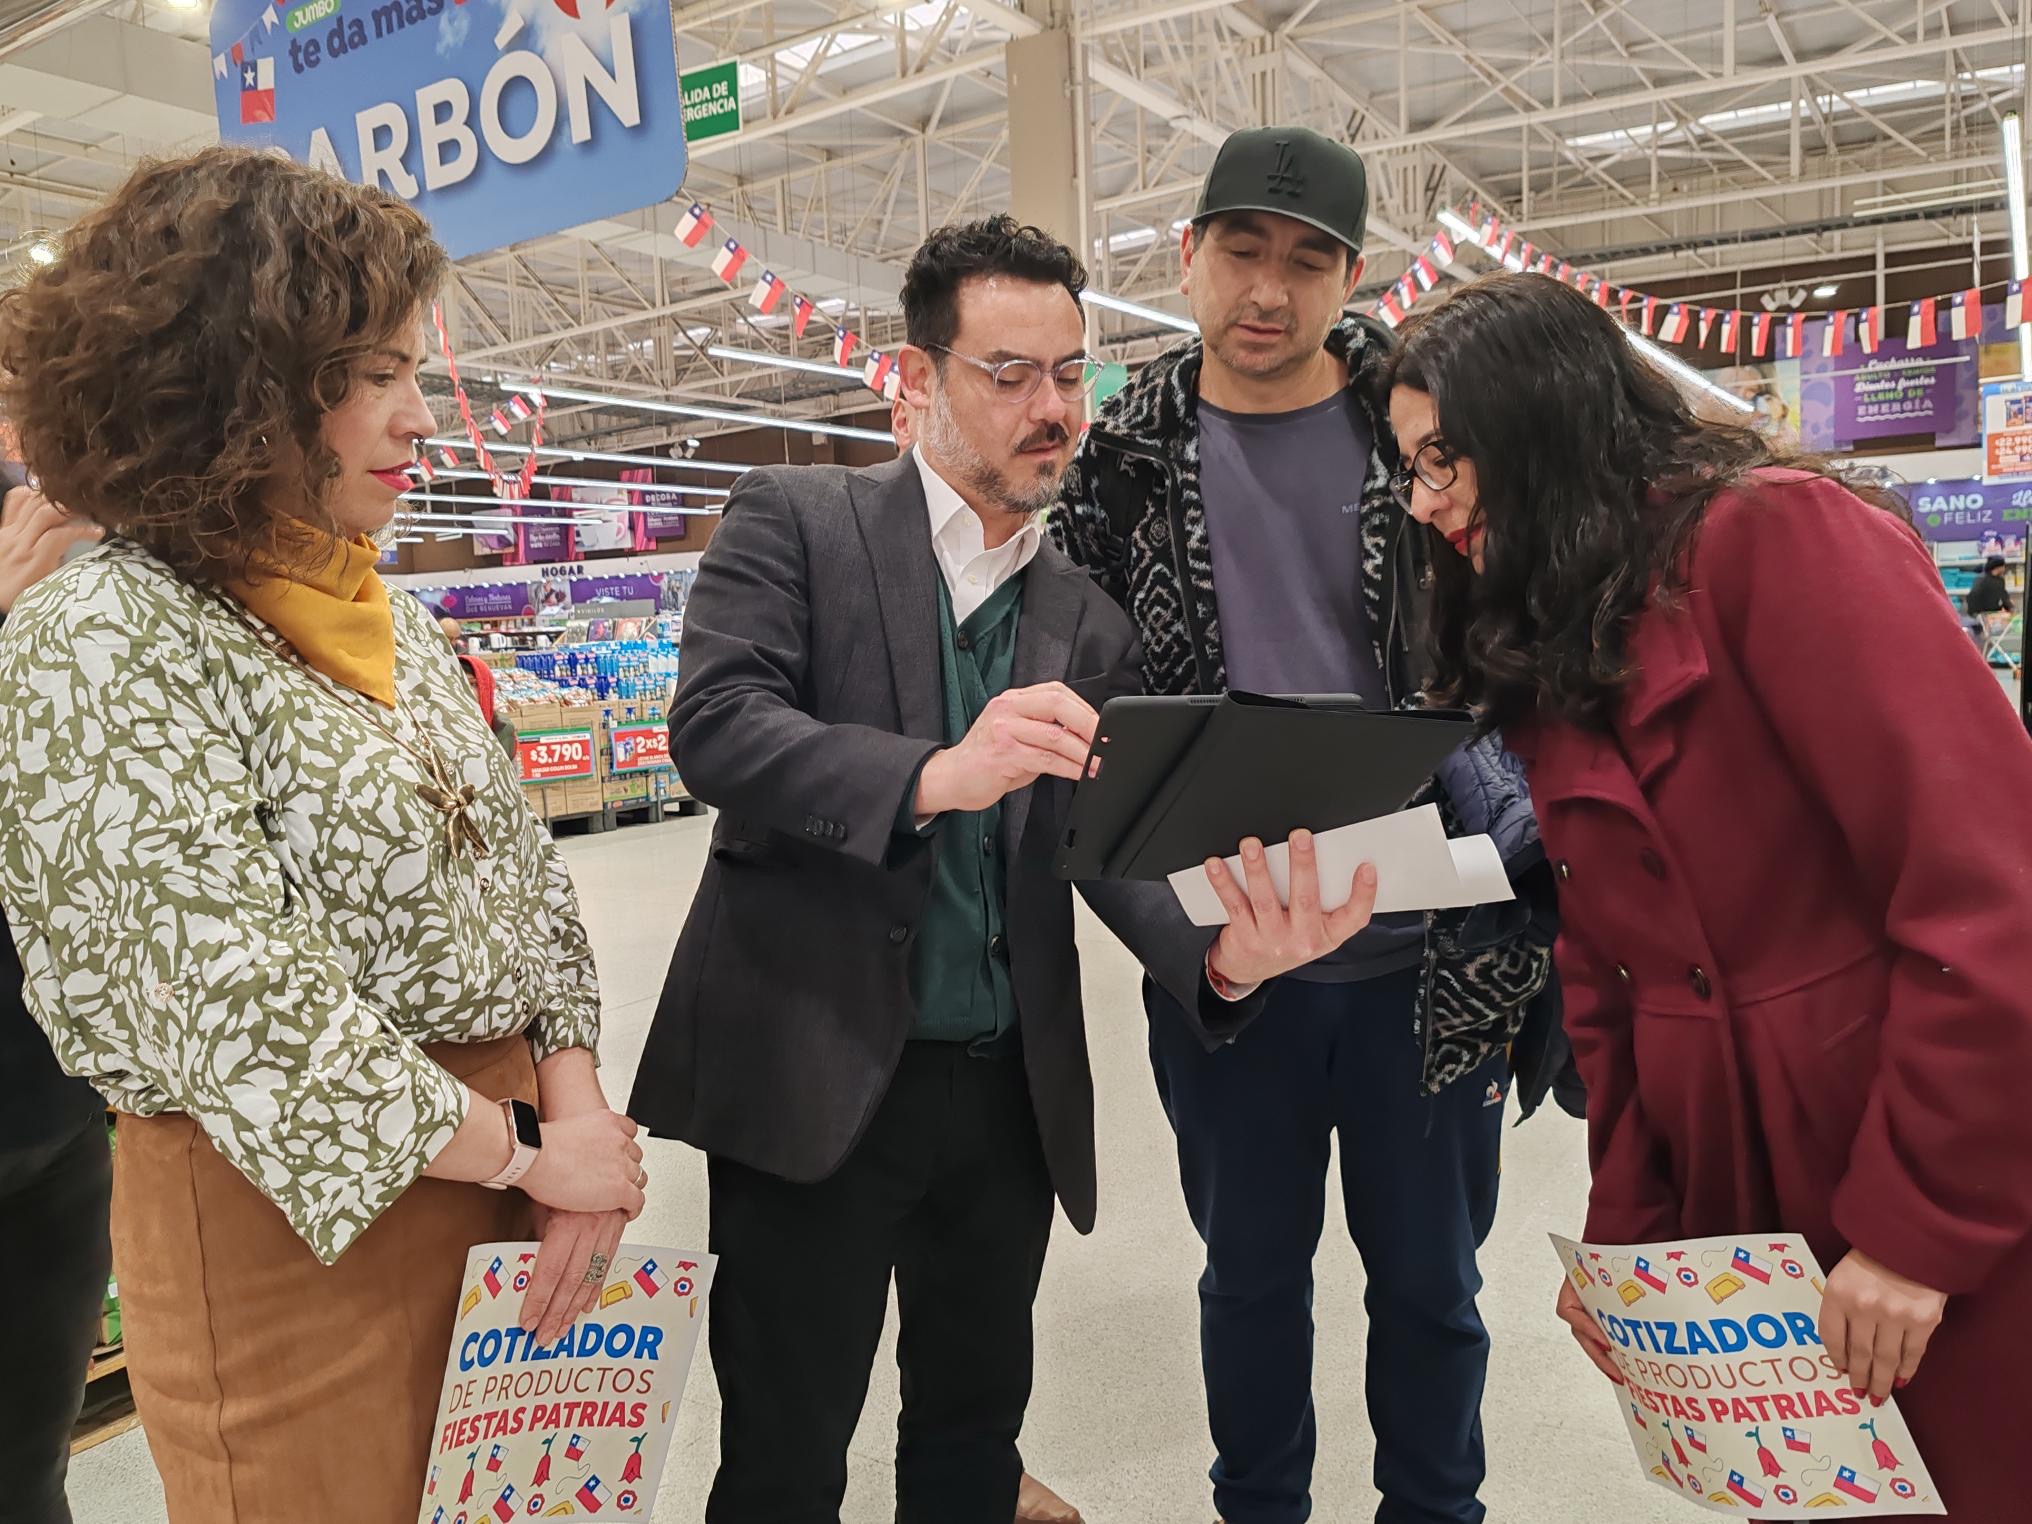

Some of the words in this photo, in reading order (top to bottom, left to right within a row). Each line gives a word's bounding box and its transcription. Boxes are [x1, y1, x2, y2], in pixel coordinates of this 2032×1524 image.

[293, 0, 335, 28] JUMBO
[288, 38, 321, 74] te
[326, 15, 368, 58] da
[262, 11, 642, 199] ARBÓN
[711, 80, 729, 99] DE
[1917, 493, 1984, 513] SANO
[1943, 510, 1993, 525] FELIZ
[542, 565, 584, 578] HOGAR
[595, 587, 621, 598] VISTE
[622, 586, 635, 596] TU
[530, 742, 583, 764] $3.790
[1596, 1307, 1825, 1356] COTIZADOR
[1634, 1353, 1843, 1390] PRODUCTOS
[448, 1379, 477, 1414] DE
[481, 1368, 654, 1405] PRODUCTOS
[1623, 1375, 1706, 1423] FIESTAS
[1707, 1388, 1861, 1424] PATRIAS
[439, 1406, 527, 1455] FIESTAS
[528, 1400, 648, 1433] PATRIAS
